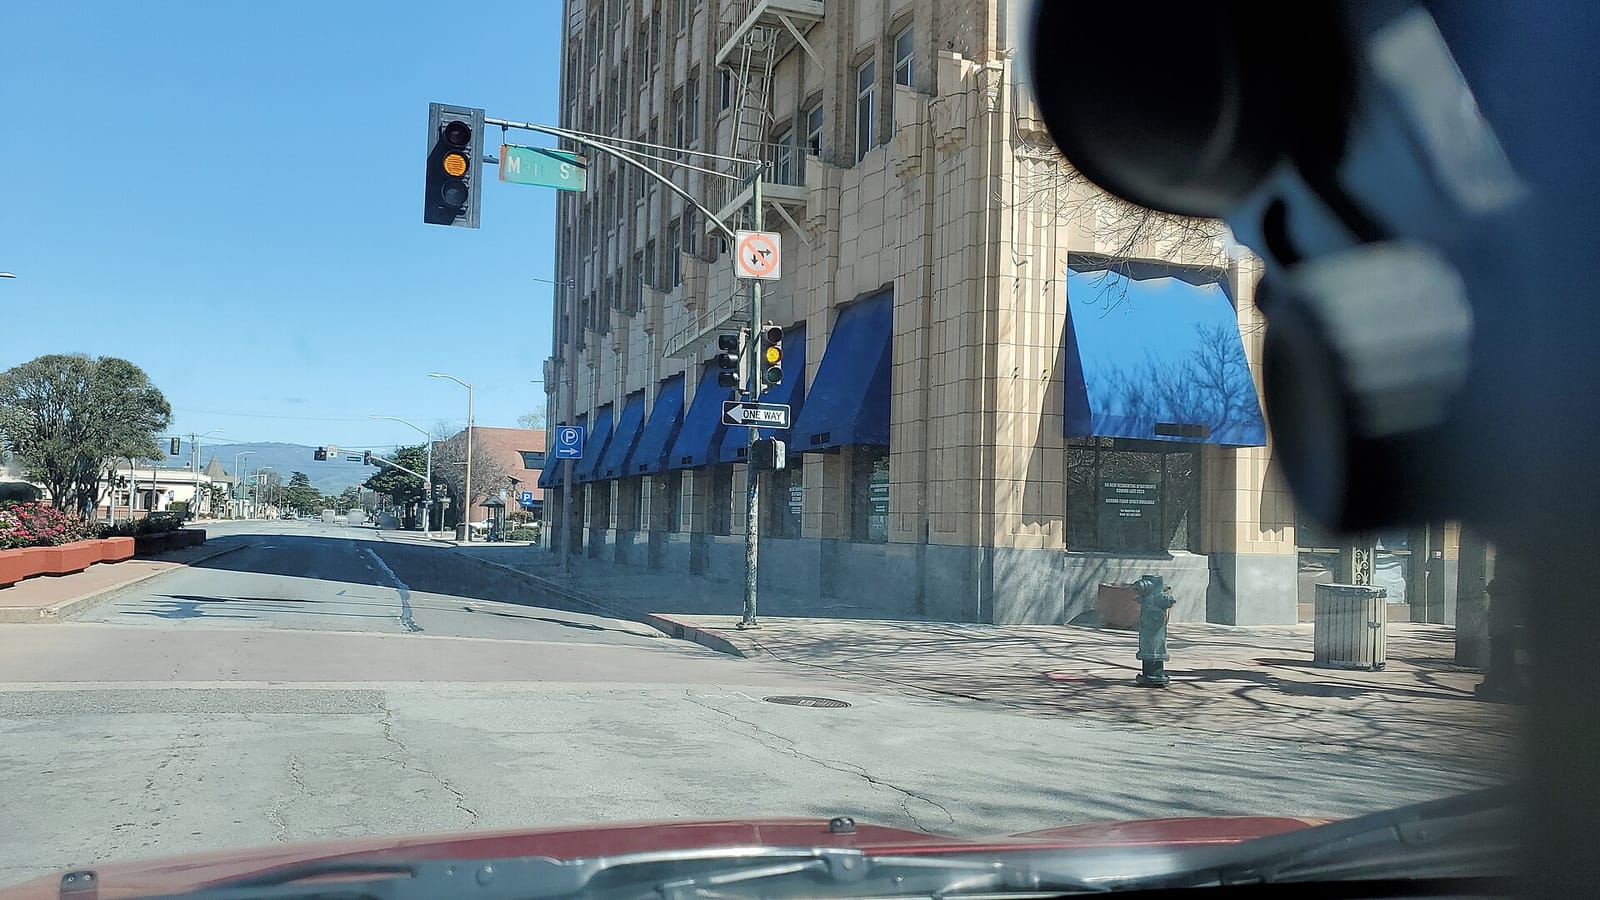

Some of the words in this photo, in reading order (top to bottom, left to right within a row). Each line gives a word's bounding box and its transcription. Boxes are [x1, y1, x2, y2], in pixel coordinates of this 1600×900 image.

[743, 409, 760, 419] ONE
[763, 411, 782, 420] WAY
[565, 430, 575, 442] P
